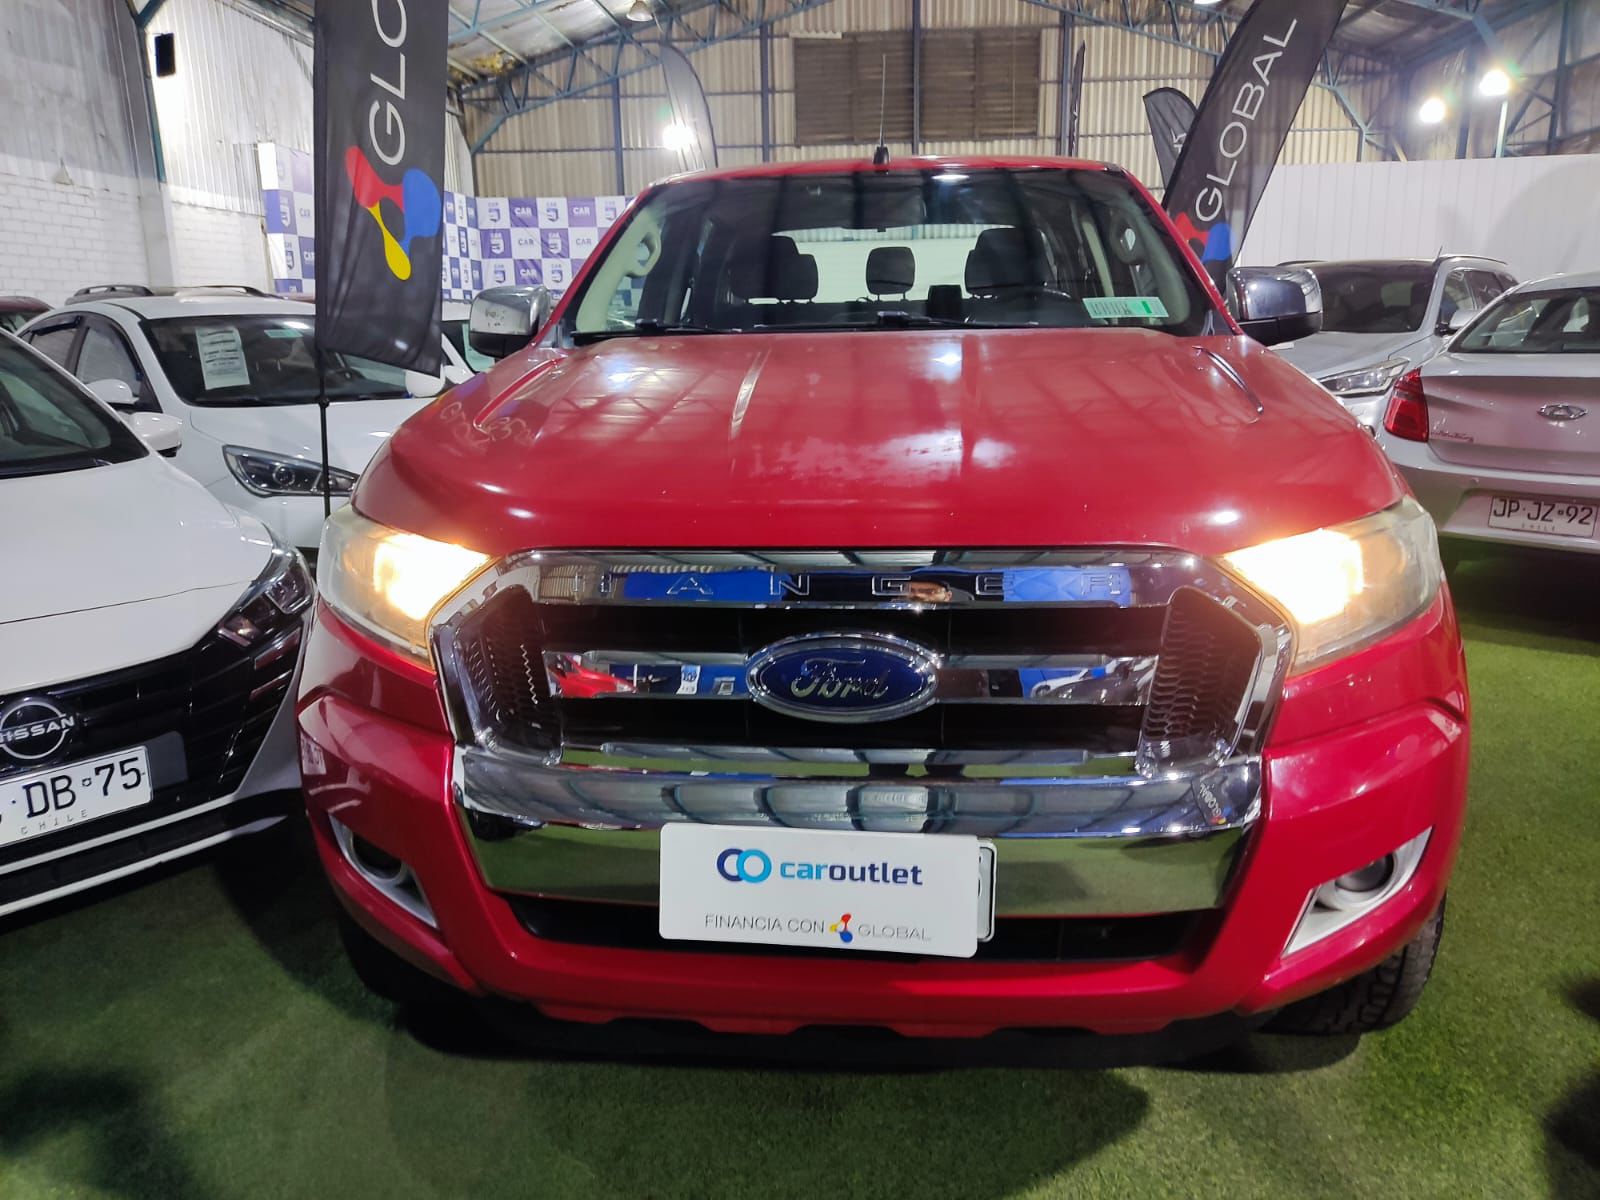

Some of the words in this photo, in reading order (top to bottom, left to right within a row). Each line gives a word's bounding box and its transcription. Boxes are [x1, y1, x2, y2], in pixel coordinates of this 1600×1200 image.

[1195, 18, 1297, 222] GLOBAL
[572, 206, 590, 217] CAR
[518, 238, 534, 246] CAR
[576, 238, 592, 246] CAR
[791, 658, 890, 698] Ford
[779, 861, 923, 885] caroutlet
[704, 914, 783, 931] FINANCIA
[787, 918, 825, 934] CON
[857, 923, 932, 941] GLOBAL
